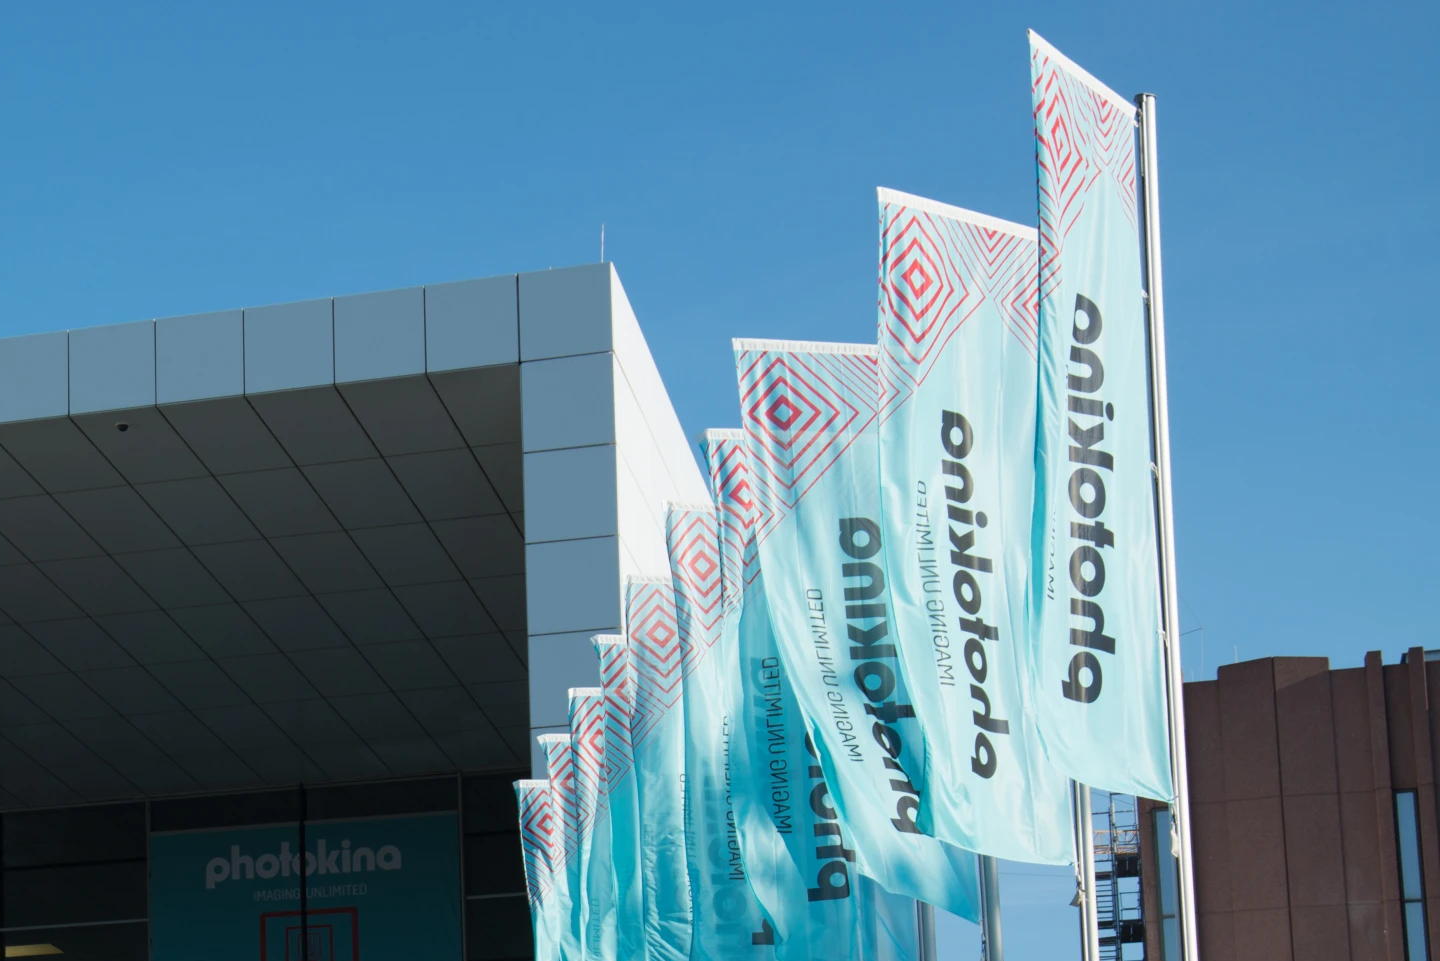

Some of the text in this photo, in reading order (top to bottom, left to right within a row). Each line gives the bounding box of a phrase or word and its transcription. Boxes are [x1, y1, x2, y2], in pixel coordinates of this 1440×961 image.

[206, 839, 402, 889] photokina
[253, 883, 367, 902] IMAGING UNLIMITED
